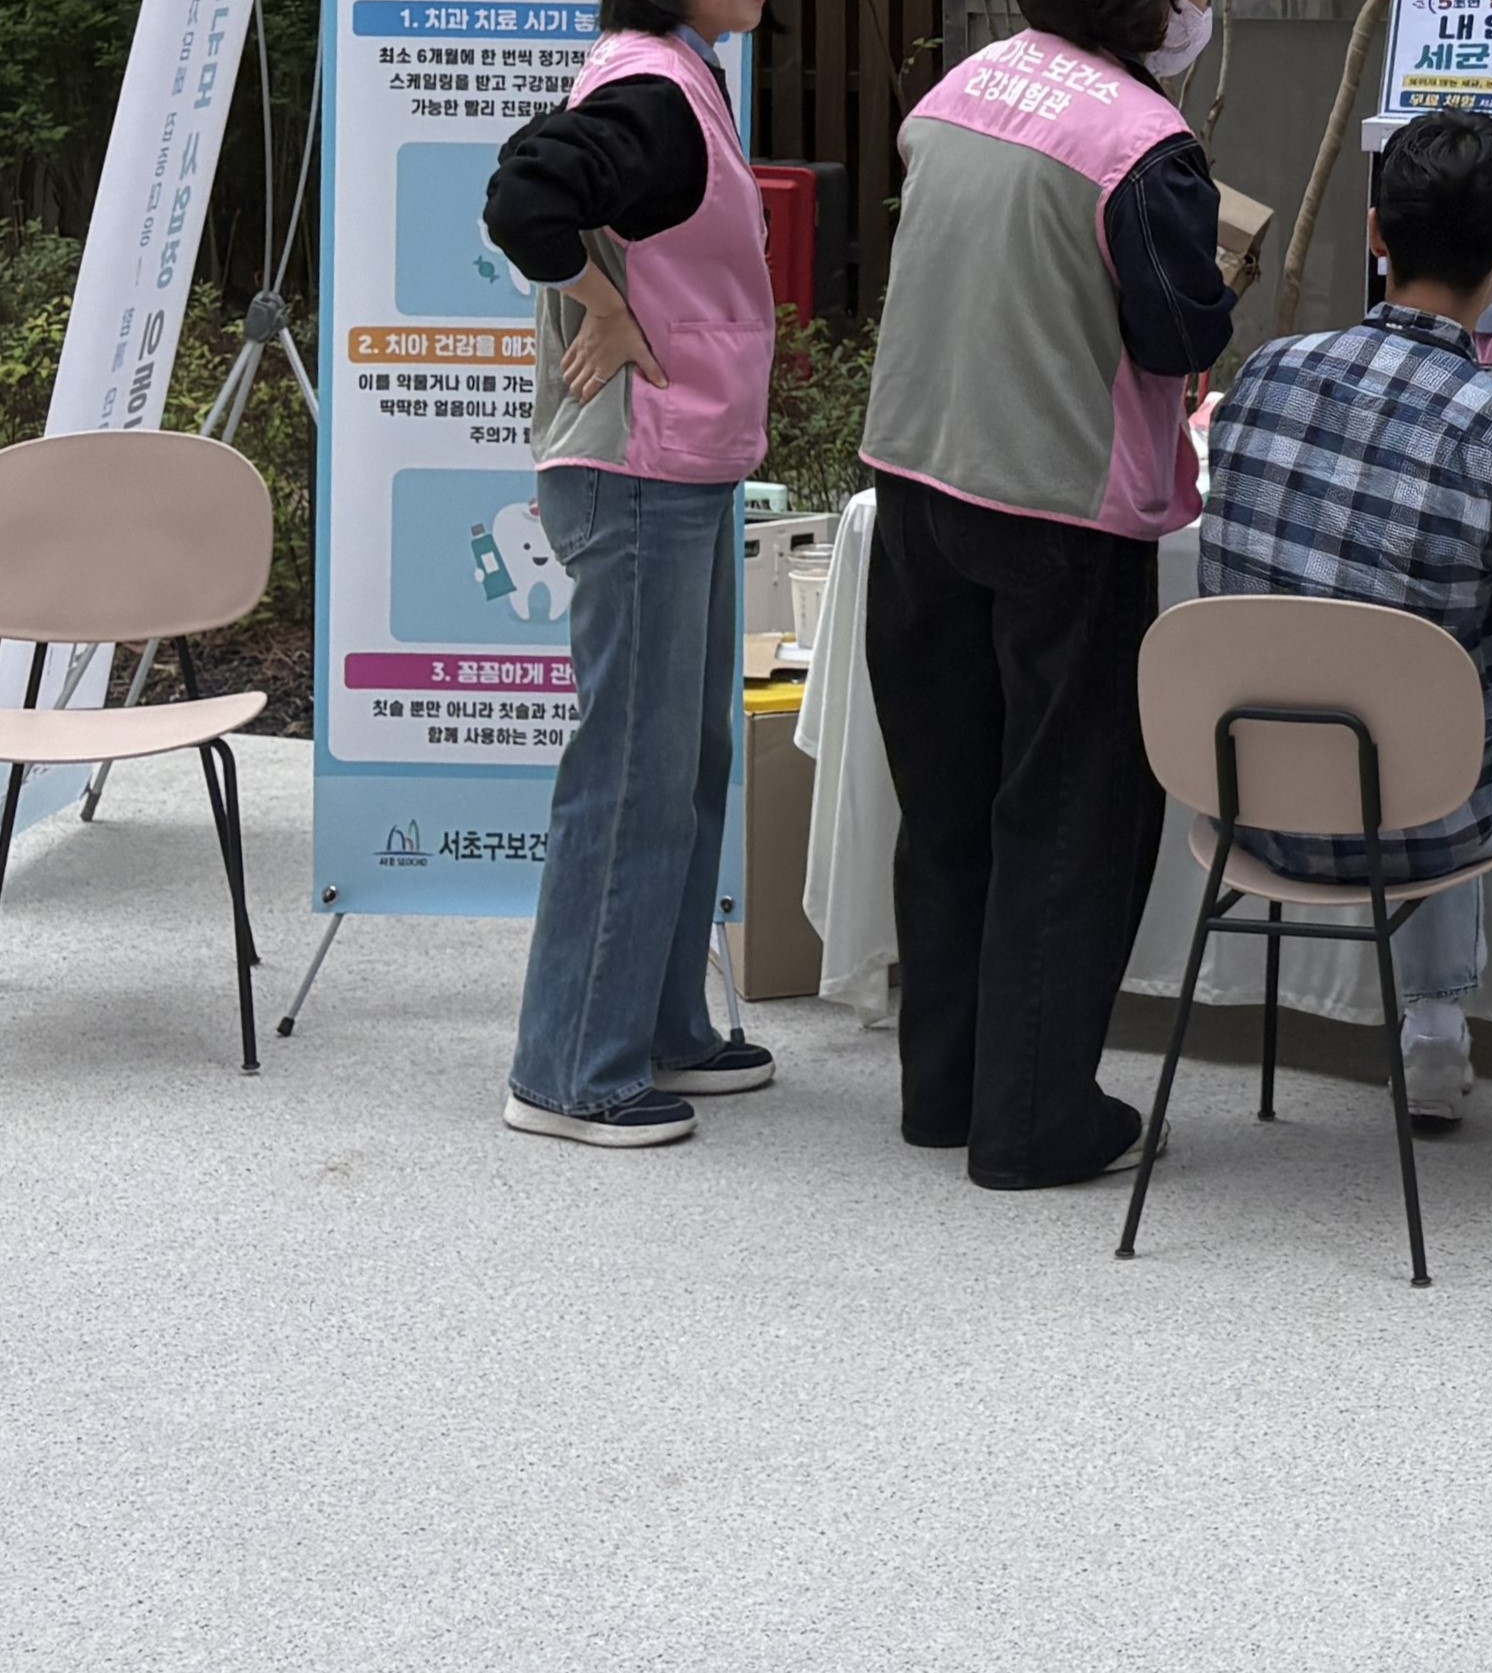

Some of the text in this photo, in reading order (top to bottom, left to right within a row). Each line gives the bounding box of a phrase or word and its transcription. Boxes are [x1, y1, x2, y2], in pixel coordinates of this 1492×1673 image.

[400, 8, 567, 30] 1. 치과 치료 시기
[1439, 14, 1474, 40] 내
[379, 47, 411, 64] 최소
[417, 48, 474, 66] 6개월에
[481, 49, 496, 66] 한
[502, 49, 532, 66] 번씩
[1414, 42, 1490, 70] 세균
[390, 73, 468, 91] 스케일링을
[475, 74, 506, 91] 받고
[1041, 53, 1120, 105] 보건소
[964, 67, 1072, 120] 건강체험관
[411, 98, 495, 117] 가능한 빨리
[358, 334, 495, 357] 2. 치아 건강을
[359, 374, 533, 393] 이를 악물거나 이를 가는
[380, 399, 428, 417] 딱딱한
[434, 400, 497, 418] 얼음이나
[470, 426, 516, 444] 주의가
[431, 661, 543, 685] 3. 꼼꼼하게
[372, 700, 546, 720] 칫솔 뿐만 아니라 칫솔과
[428, 726, 458, 744] 함께
[464, 728, 527, 746] 사용하는
[533, 729, 563, 747] 것이
